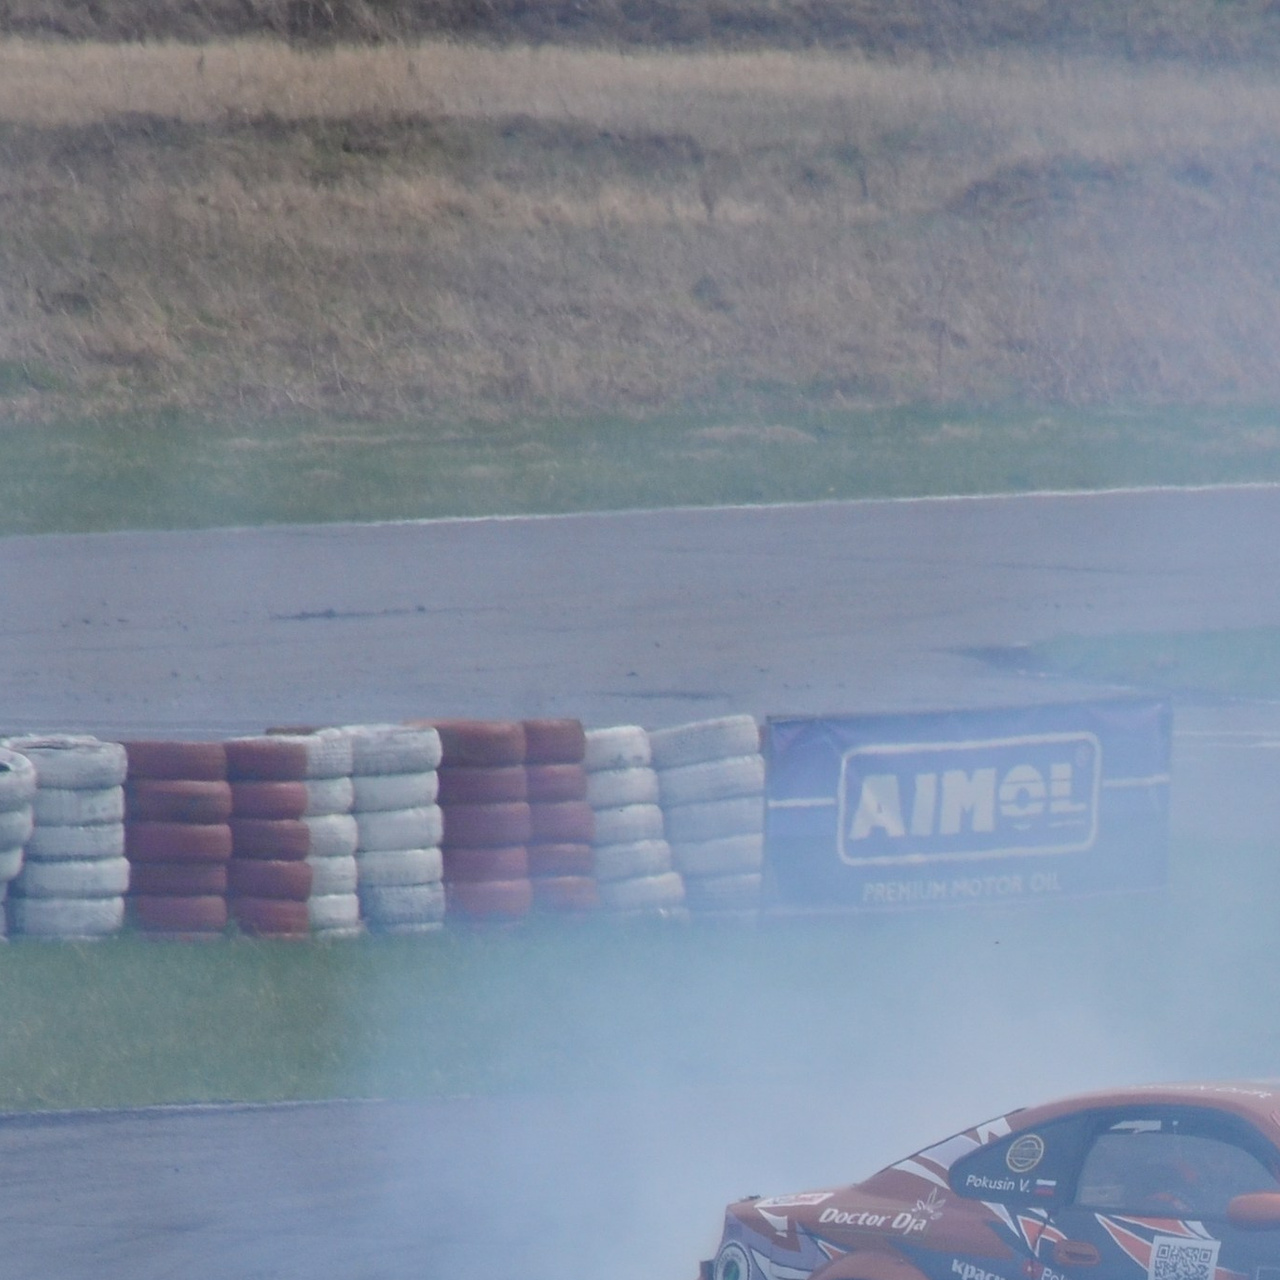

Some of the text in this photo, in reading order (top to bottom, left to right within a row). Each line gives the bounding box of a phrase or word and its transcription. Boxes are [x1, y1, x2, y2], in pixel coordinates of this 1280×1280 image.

[848, 762, 1087, 842] AIMOL
[862, 872, 1062, 902] PREMIUM MOTOR OIL
[966, 1174, 1031, 1193] Pokusin V.
[819, 1206, 928, 1235] Doctor Dja
